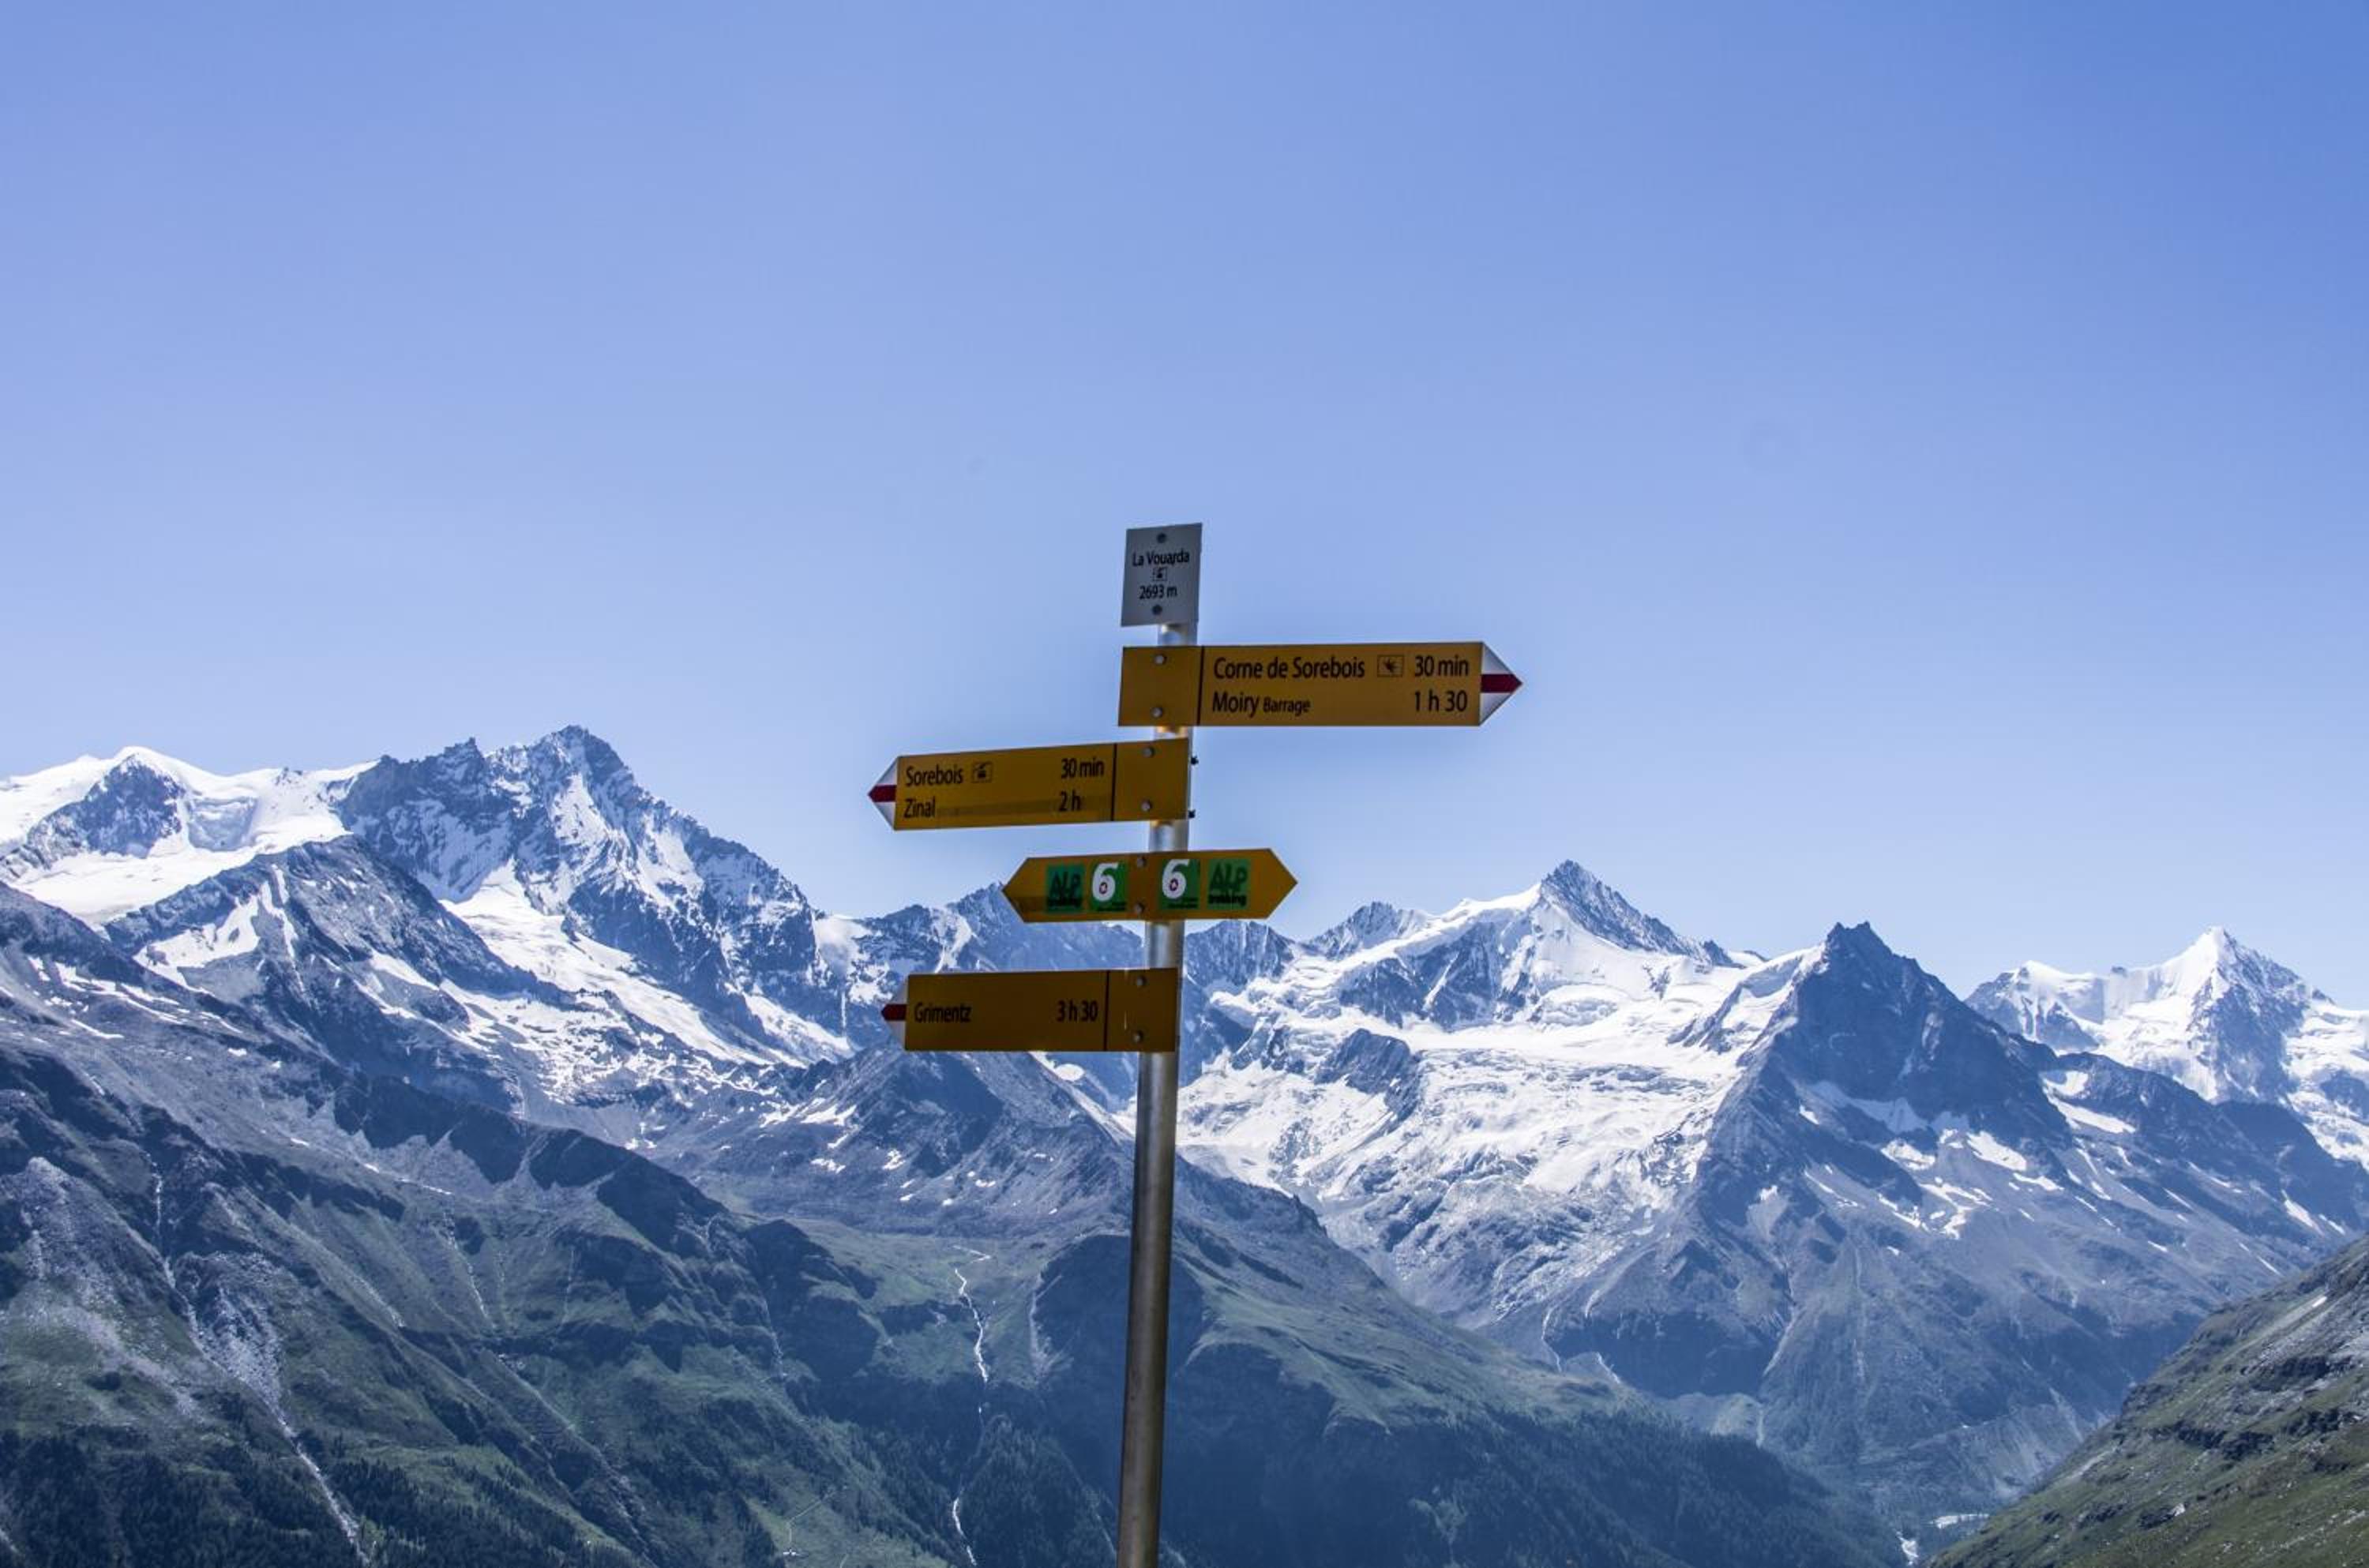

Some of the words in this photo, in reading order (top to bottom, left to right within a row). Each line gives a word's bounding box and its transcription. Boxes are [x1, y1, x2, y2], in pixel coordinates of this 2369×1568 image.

[1132, 552, 1144, 567] La
[1146, 549, 1190, 566] Vouarda
[1139, 584, 1165, 600] 2693
[1166, 585, 1177, 598] m
[1267, 656, 1288, 679] de
[1292, 655, 1365, 679] Sorebois
[1414, 655, 1435, 677] 30
[1438, 654, 1469, 677] min
[1212, 691, 1260, 718] Moiry
[1263, 696, 1311, 717] Barrage
[1414, 689, 1421, 712] 1
[1428, 688, 1440, 712] h
[1444, 688, 1468, 712] 30
[905, 763, 963, 787] Sorebois
[1061, 757, 1078, 779] 30
[1079, 755, 1105, 778] min
[903, 796, 937, 819] Zinal
[1059, 790, 1068, 812] 2
[1071, 789, 1081, 812] h
[1049, 872, 1082, 898] ALP
[1091, 861, 1120, 902] 6
[1162, 858, 1190, 900] 6
[1209, 862, 1248, 892] ALP
[914, 1001, 972, 1024] Grimentz
[1057, 1000, 1066, 1022] 3
[1068, 999, 1079, 1022] h
[1080, 1000, 1098, 1022] 30
